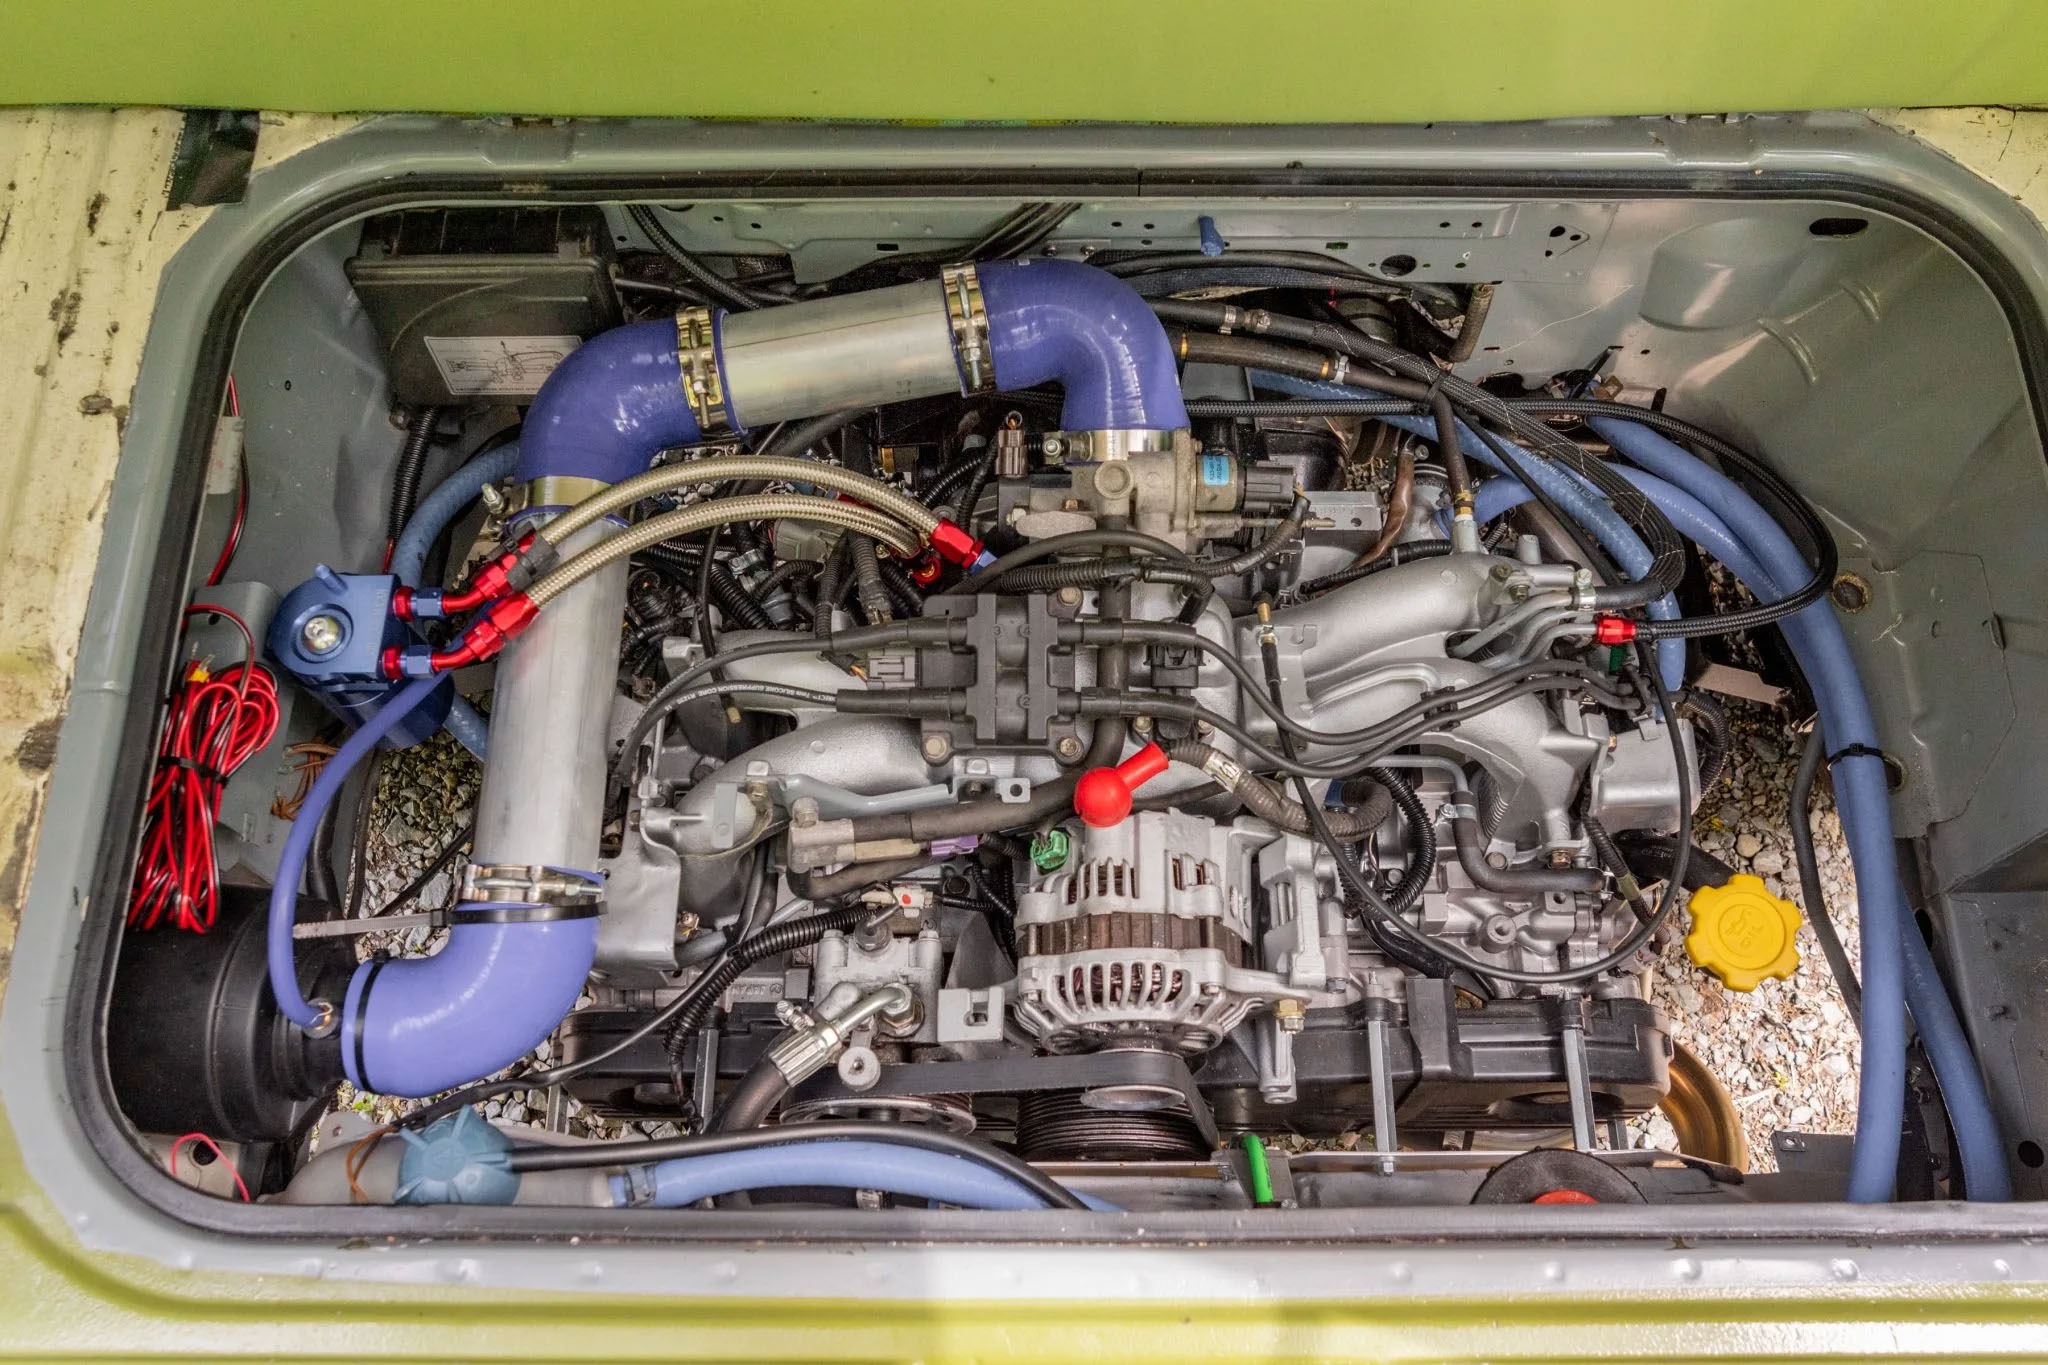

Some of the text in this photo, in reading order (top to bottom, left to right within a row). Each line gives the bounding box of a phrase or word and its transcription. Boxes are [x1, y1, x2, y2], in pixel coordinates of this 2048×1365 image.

[1518, 447, 1598, 503] SILICONE HEATER
[698, 687, 717, 697] CORE
[716, 684, 765, 693] SUPPRESSION
[765, 686, 796, 695] SILICONE
